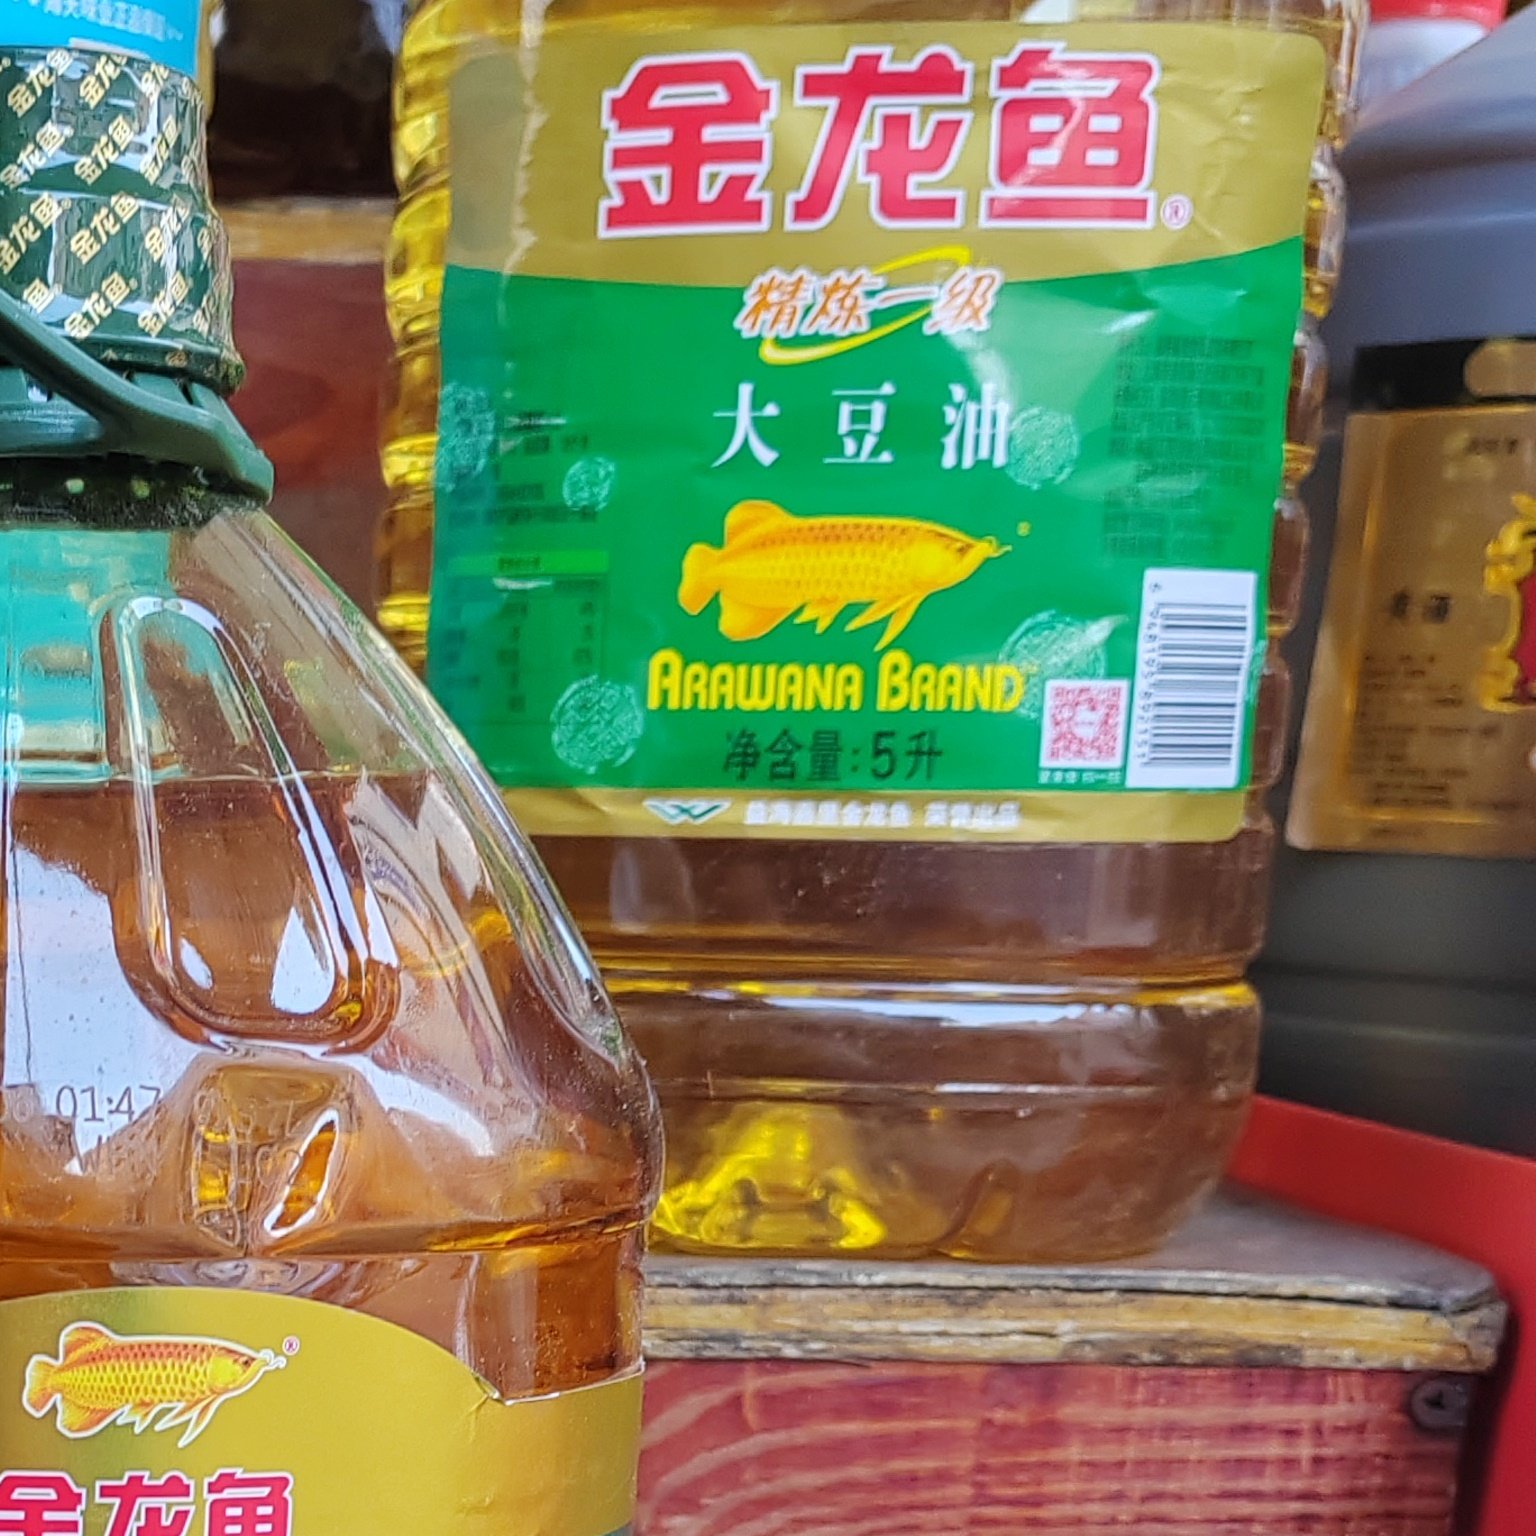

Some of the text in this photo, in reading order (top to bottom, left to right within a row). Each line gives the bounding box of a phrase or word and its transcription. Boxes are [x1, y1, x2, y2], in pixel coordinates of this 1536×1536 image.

[601, 46, 1158, 235] 金龙鱼
[733, 267, 1005, 338] 精炼一级
[710, 381, 1010, 470] 大豆油
[647, 647, 863, 711] ARAWANA
[876, 649, 1026, 712] BRAND
